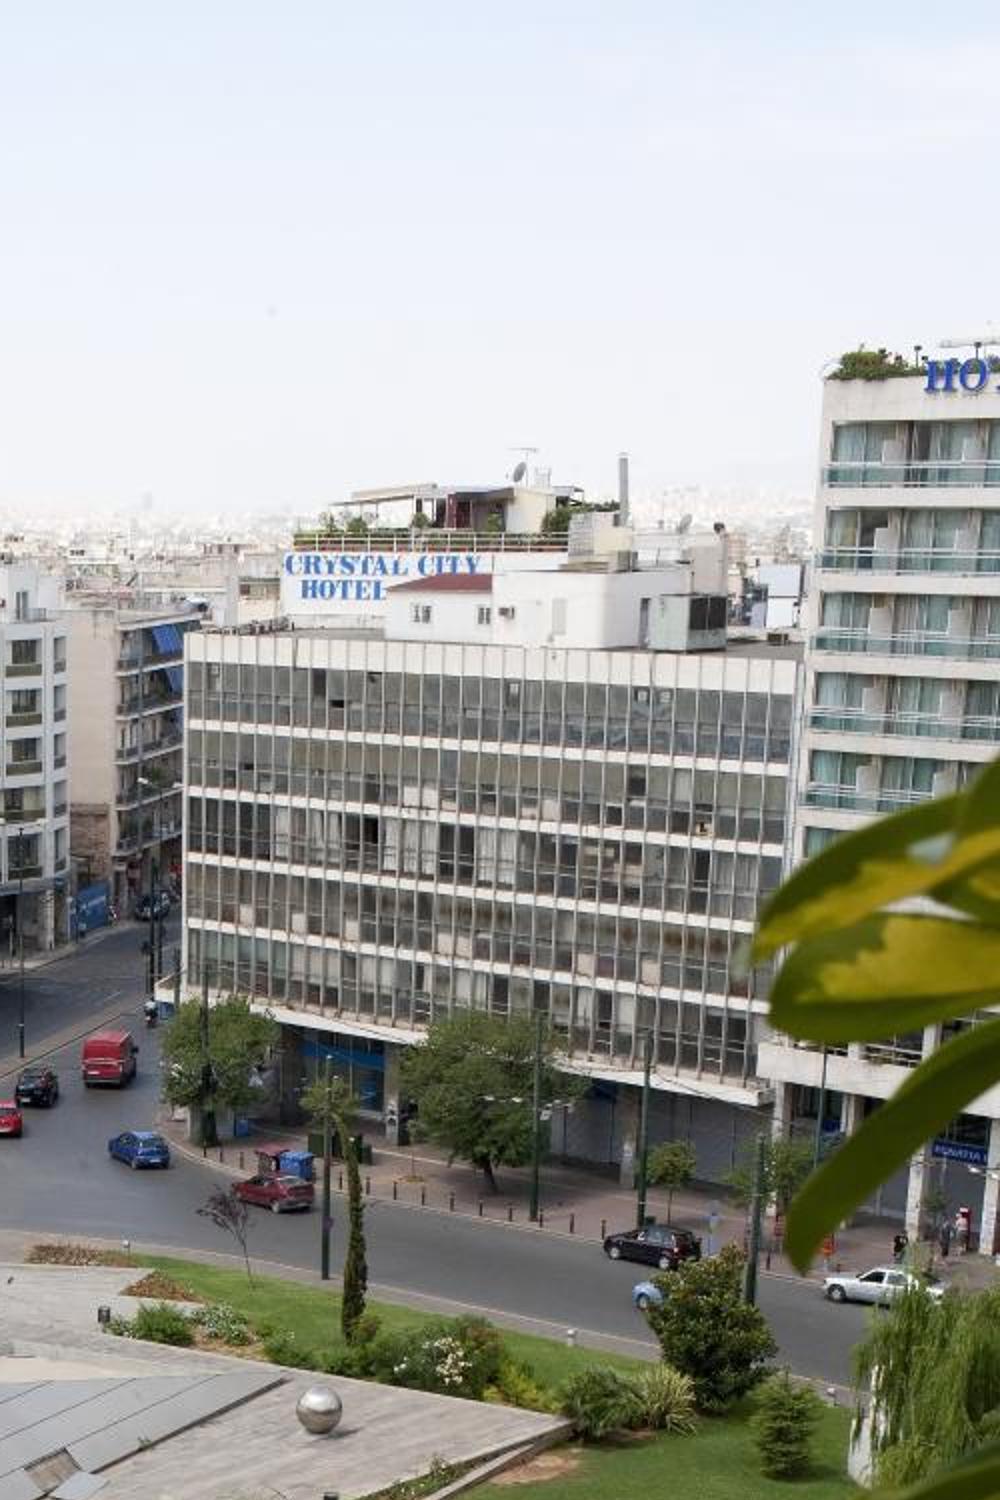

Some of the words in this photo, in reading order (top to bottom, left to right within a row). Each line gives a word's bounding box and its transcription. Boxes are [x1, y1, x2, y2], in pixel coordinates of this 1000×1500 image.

[924, 357, 1000, 394] HO
[284, 554, 408, 576] CRYSTAL
[417, 554, 482, 576] CITY
[301, 578, 387, 600] HOTEL
